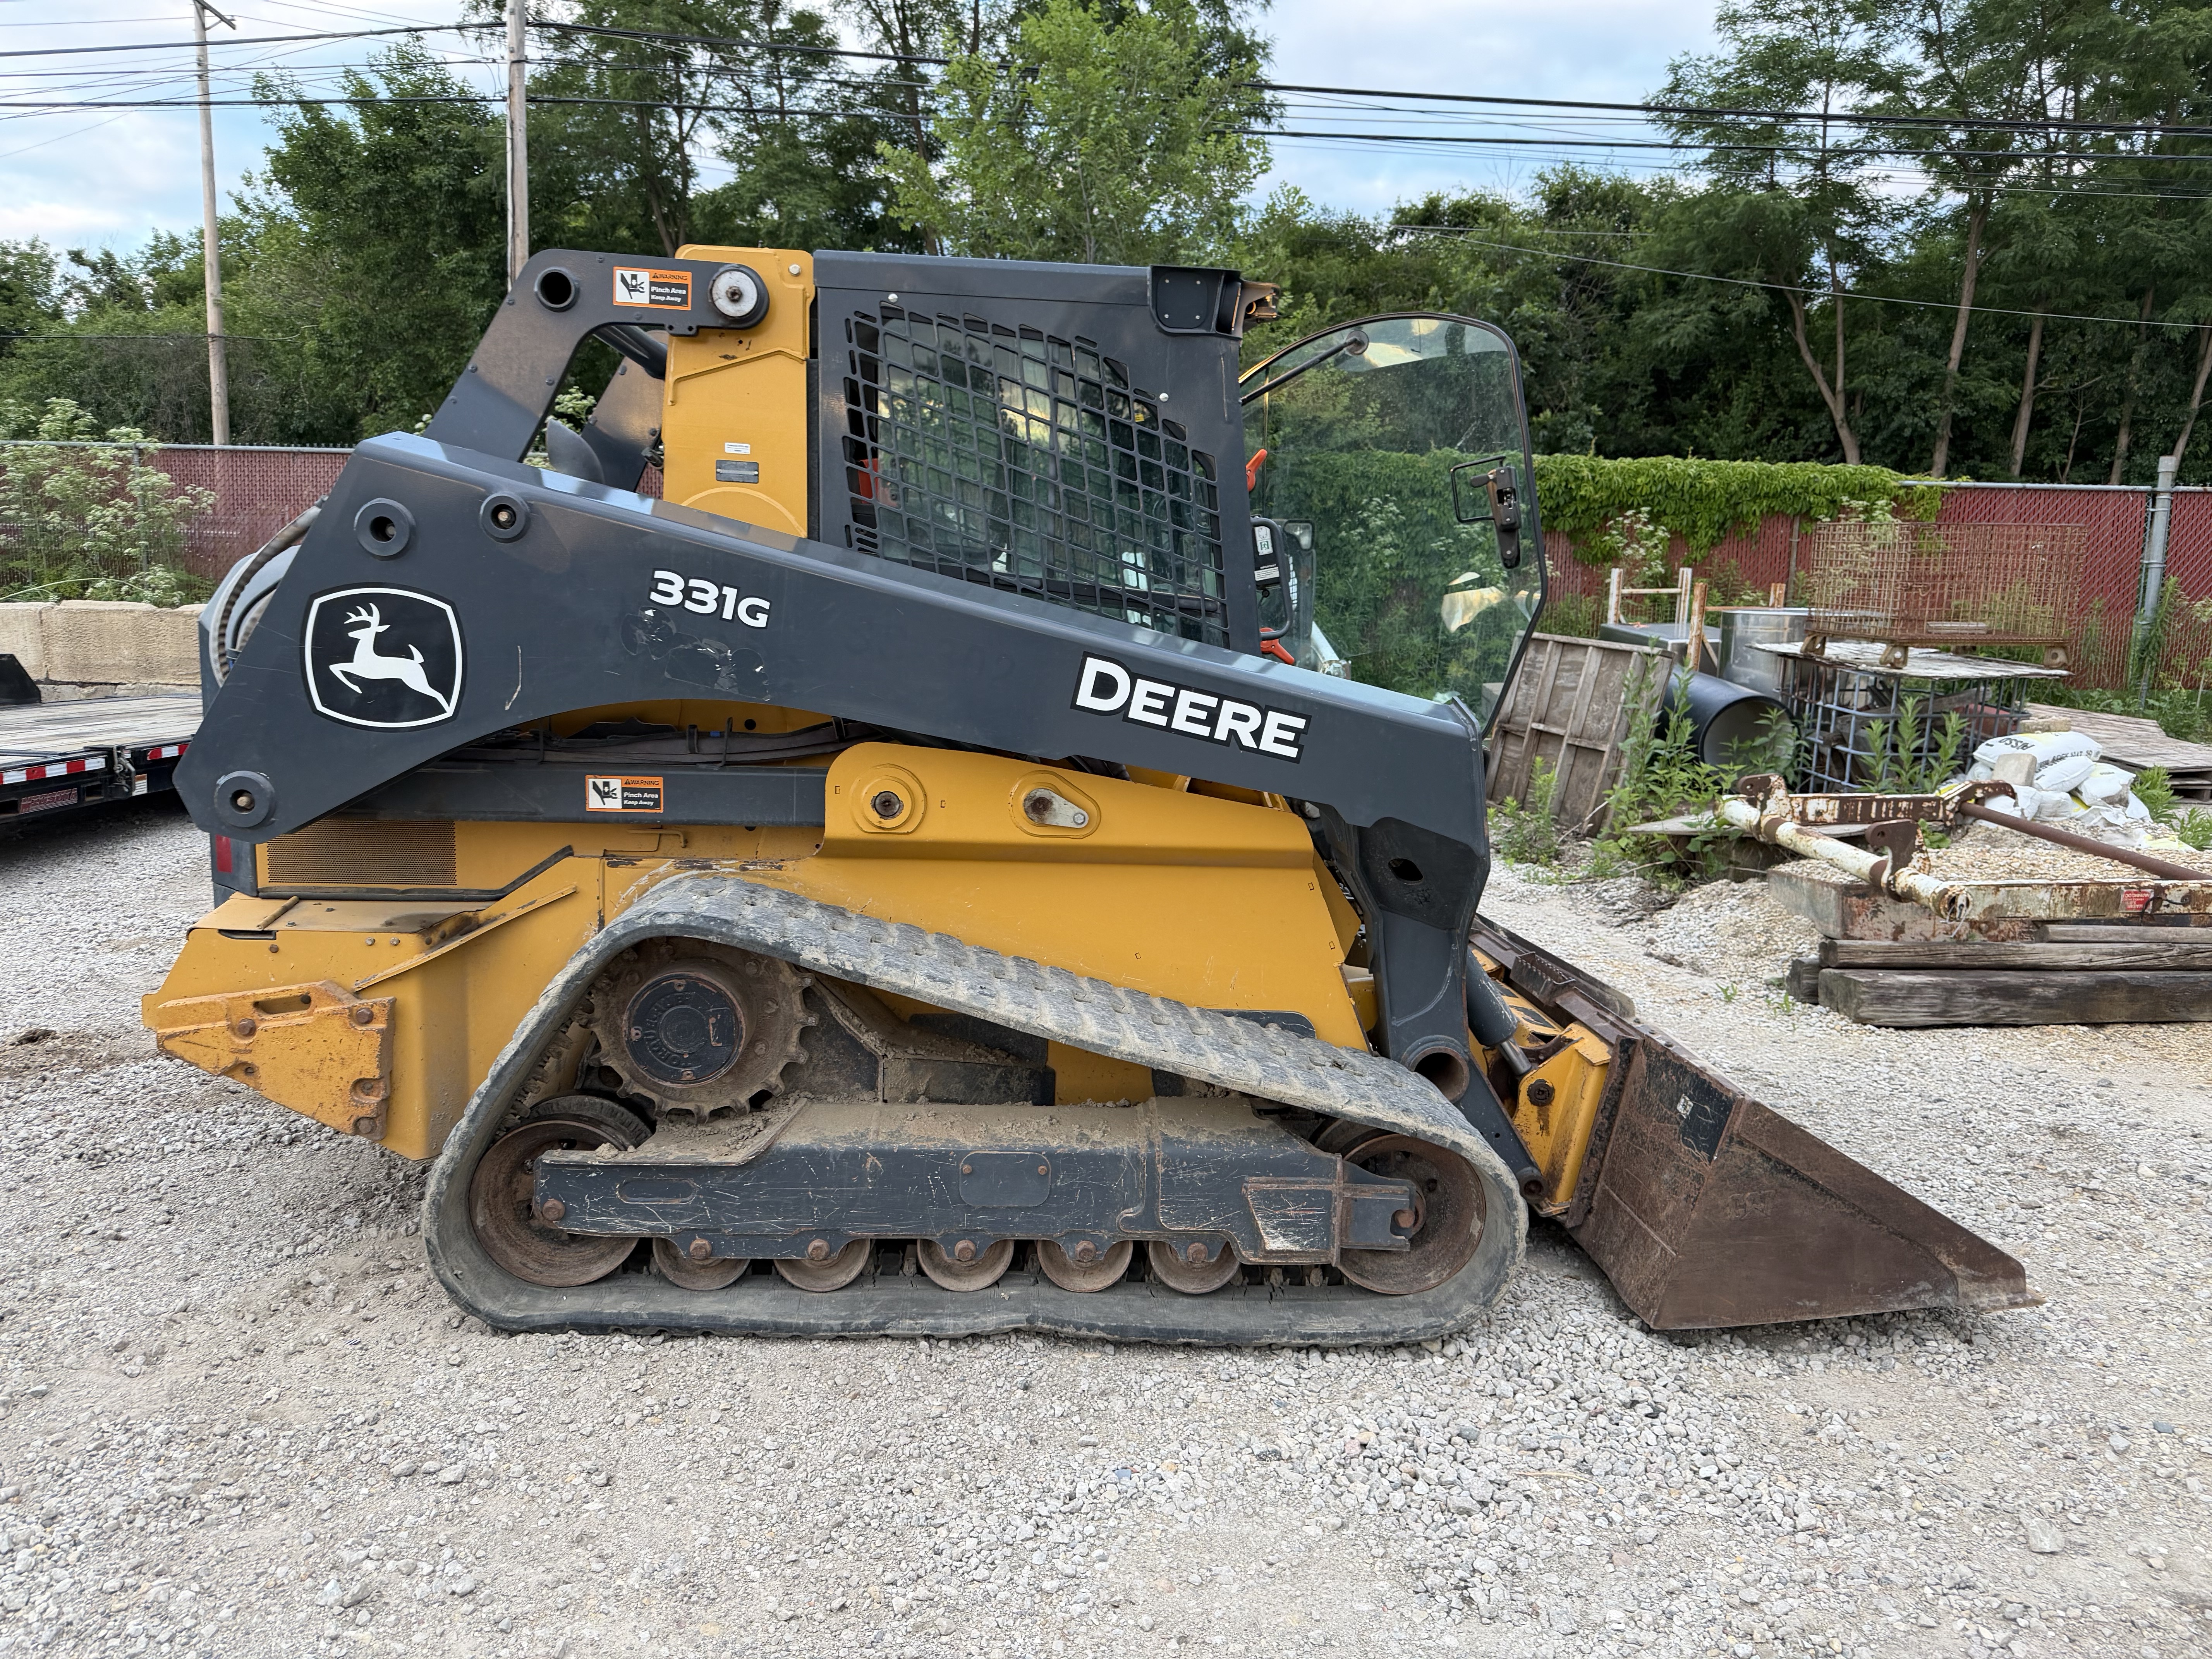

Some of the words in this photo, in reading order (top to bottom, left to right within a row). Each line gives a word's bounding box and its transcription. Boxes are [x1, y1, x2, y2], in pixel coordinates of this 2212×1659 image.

[650, 570, 770, 627] 331G
[1076, 657, 1306, 758] DEERE
[1998, 737, 2035, 750] RUSSO
